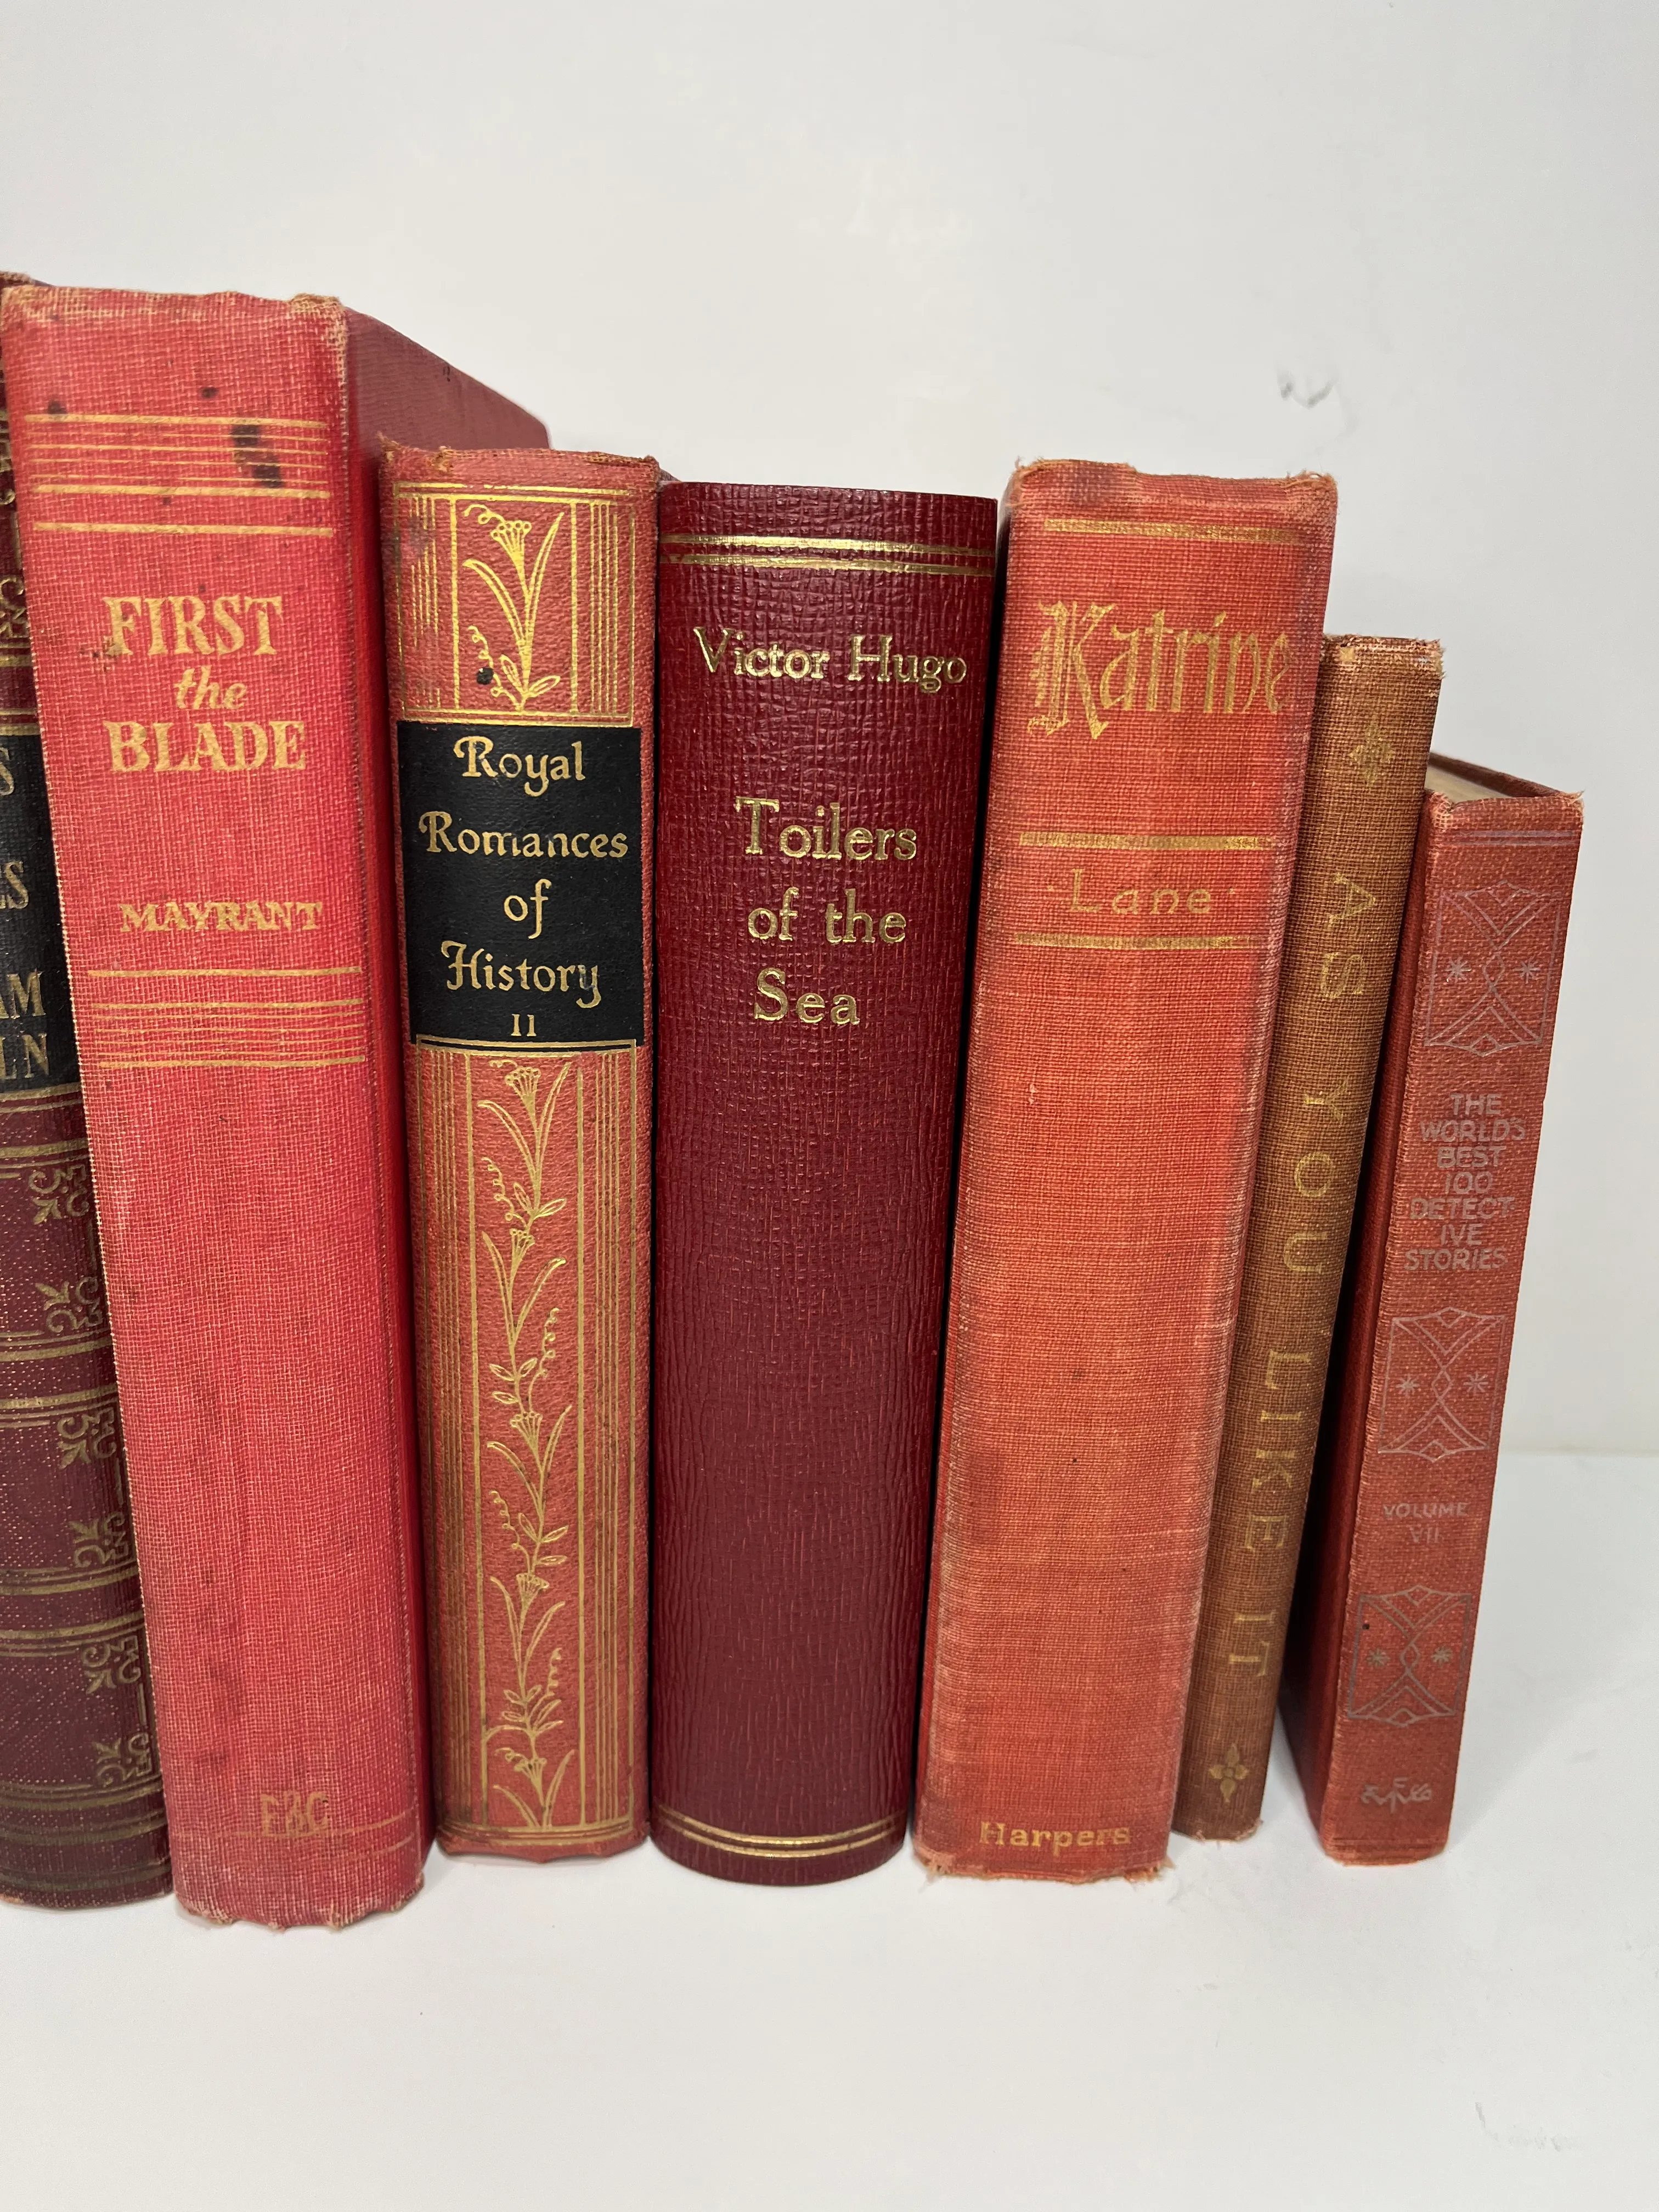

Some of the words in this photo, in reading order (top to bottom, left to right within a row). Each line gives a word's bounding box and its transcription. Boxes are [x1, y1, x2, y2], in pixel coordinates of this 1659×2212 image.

[104, 594, 284, 656] FIRST
[174, 664, 249, 710] the
[693, 626, 831, 680] Victor
[848, 634, 968, 694] Hugo
[1027, 601, 1293, 740] Katrine
[104, 720, 307, 773] BLADE
[453, 735, 586, 797] Royal
[419, 810, 629, 859] Romances
[735, 796, 917, 861] Toilers
[120, 901, 324, 933] MAYRANT
[504, 878, 552, 939] of
[747, 886, 800, 942] of
[825, 887, 907, 944] the
[1068, 868, 1213, 916] Lane
[1320, 871, 1376, 1000] AS
[441, 940, 602, 1008] History
[753, 967, 860, 1025] Sea
[511, 1013, 537, 1037] II
[1449, 1092, 1503, 1116] THE
[1283, 1076, 1352, 1274] YOU
[1436, 1145, 1507, 1169] BEST
[1444, 1171, 1494, 1195] 100
[1402, 1246, 1508, 1271] STORIES
[1440, 1223, 1483, 1246] IVE
[1244, 1348, 1313, 1553] LIKE
[1383, 1502, 1471, 1519] VOLUME
[1227, 1609, 1277, 1678] IT
[979, 1821, 1132, 1857] Harpers
